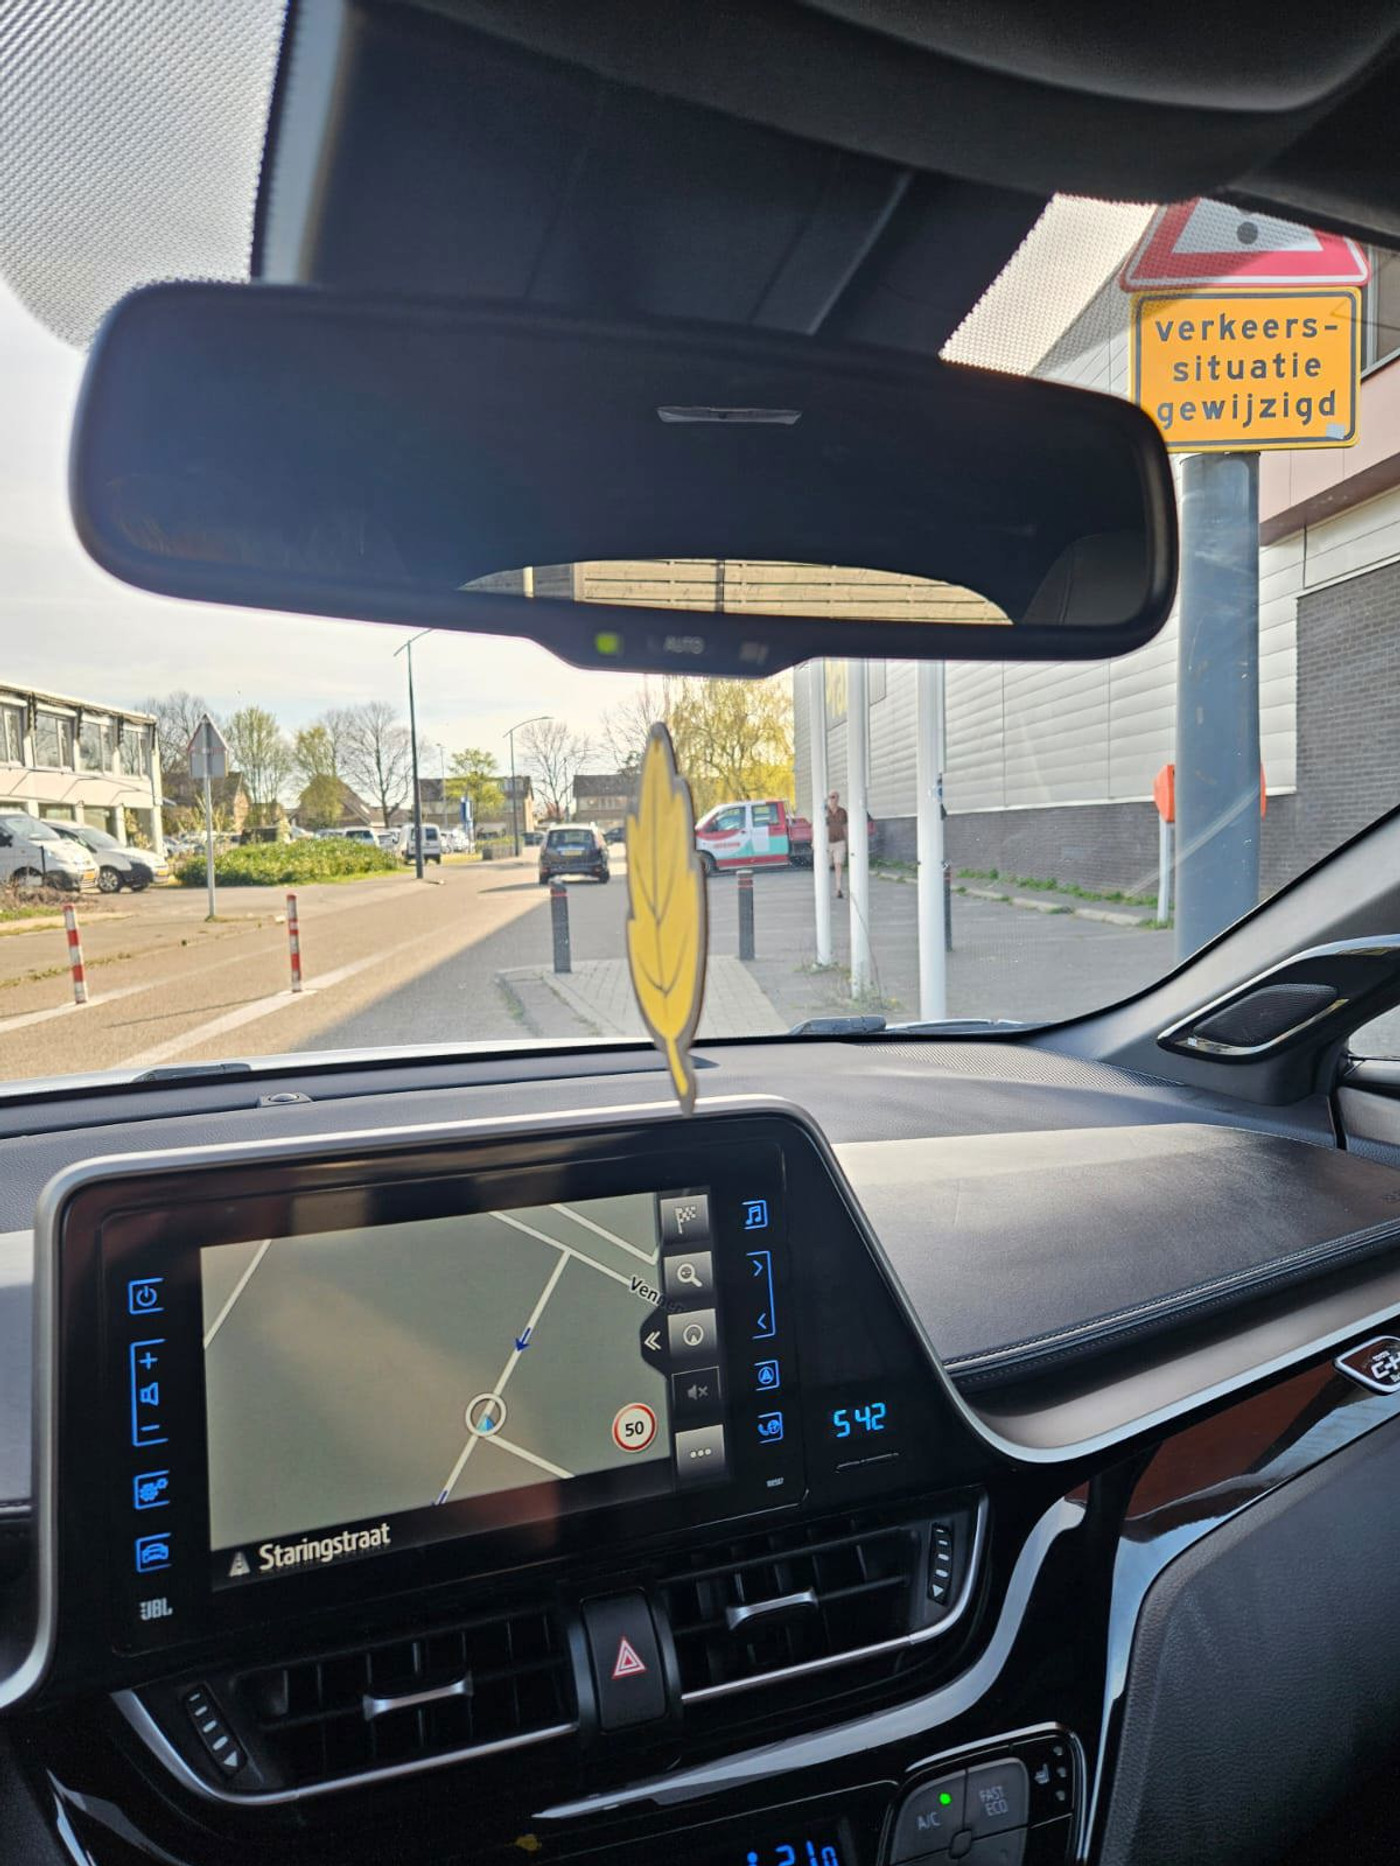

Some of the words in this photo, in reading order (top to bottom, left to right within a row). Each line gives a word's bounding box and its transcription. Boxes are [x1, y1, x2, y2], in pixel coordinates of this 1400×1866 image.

[1155, 312, 1338, 342] verkeers-
[1172, 351, 1321, 382] situatie
[1156, 388, 1336, 430] gewijzigd
[625, 1420, 645, 1438] 50
[258, 1522, 391, 1571] Staringstraat
[140, 1597, 173, 1620] JBL
[980, 1786, 1005, 1801] FAST
[986, 1800, 1008, 1816] ECO
[917, 1812, 941, 1830] A/C
